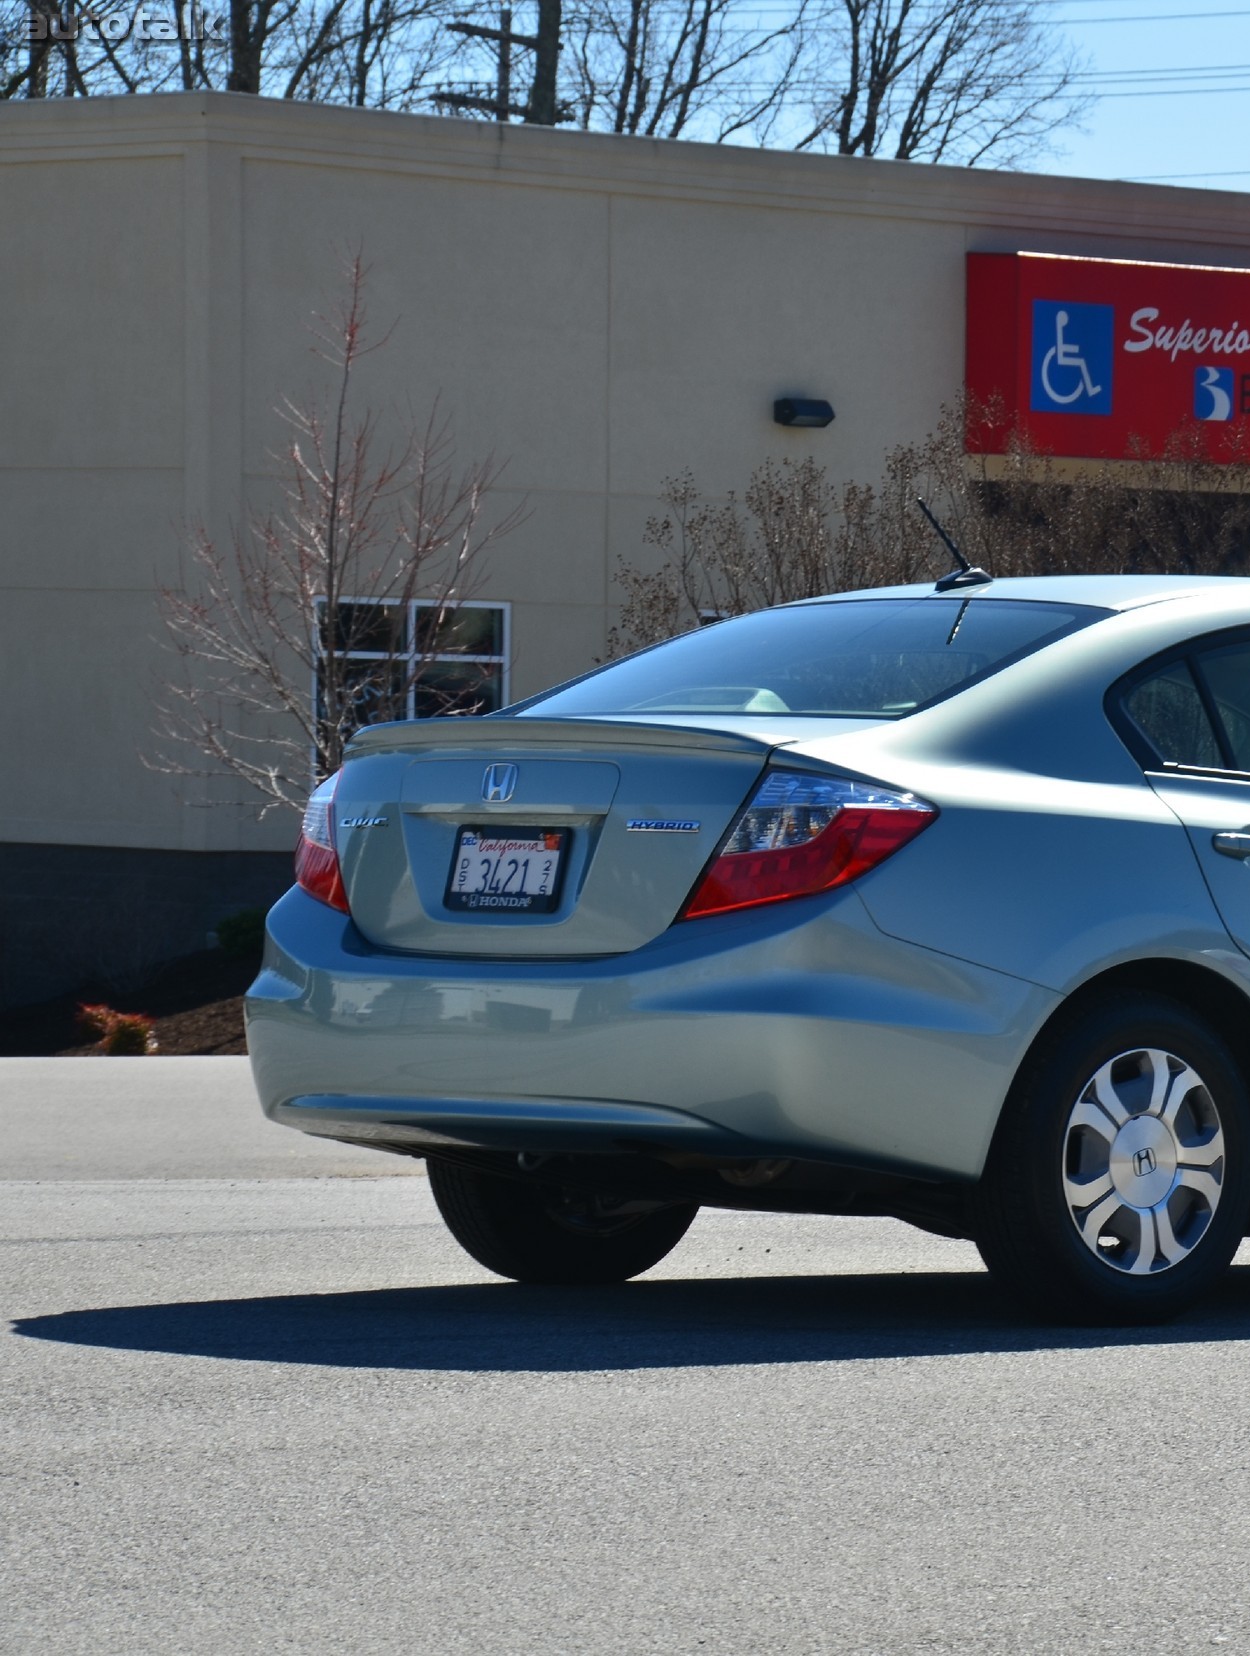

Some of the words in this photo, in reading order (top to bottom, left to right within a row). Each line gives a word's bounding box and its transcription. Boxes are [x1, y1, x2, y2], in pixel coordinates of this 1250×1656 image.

[479, 839, 544, 857] California
[475, 858, 530, 894] 3421
[479, 896, 528, 907] HONDA
